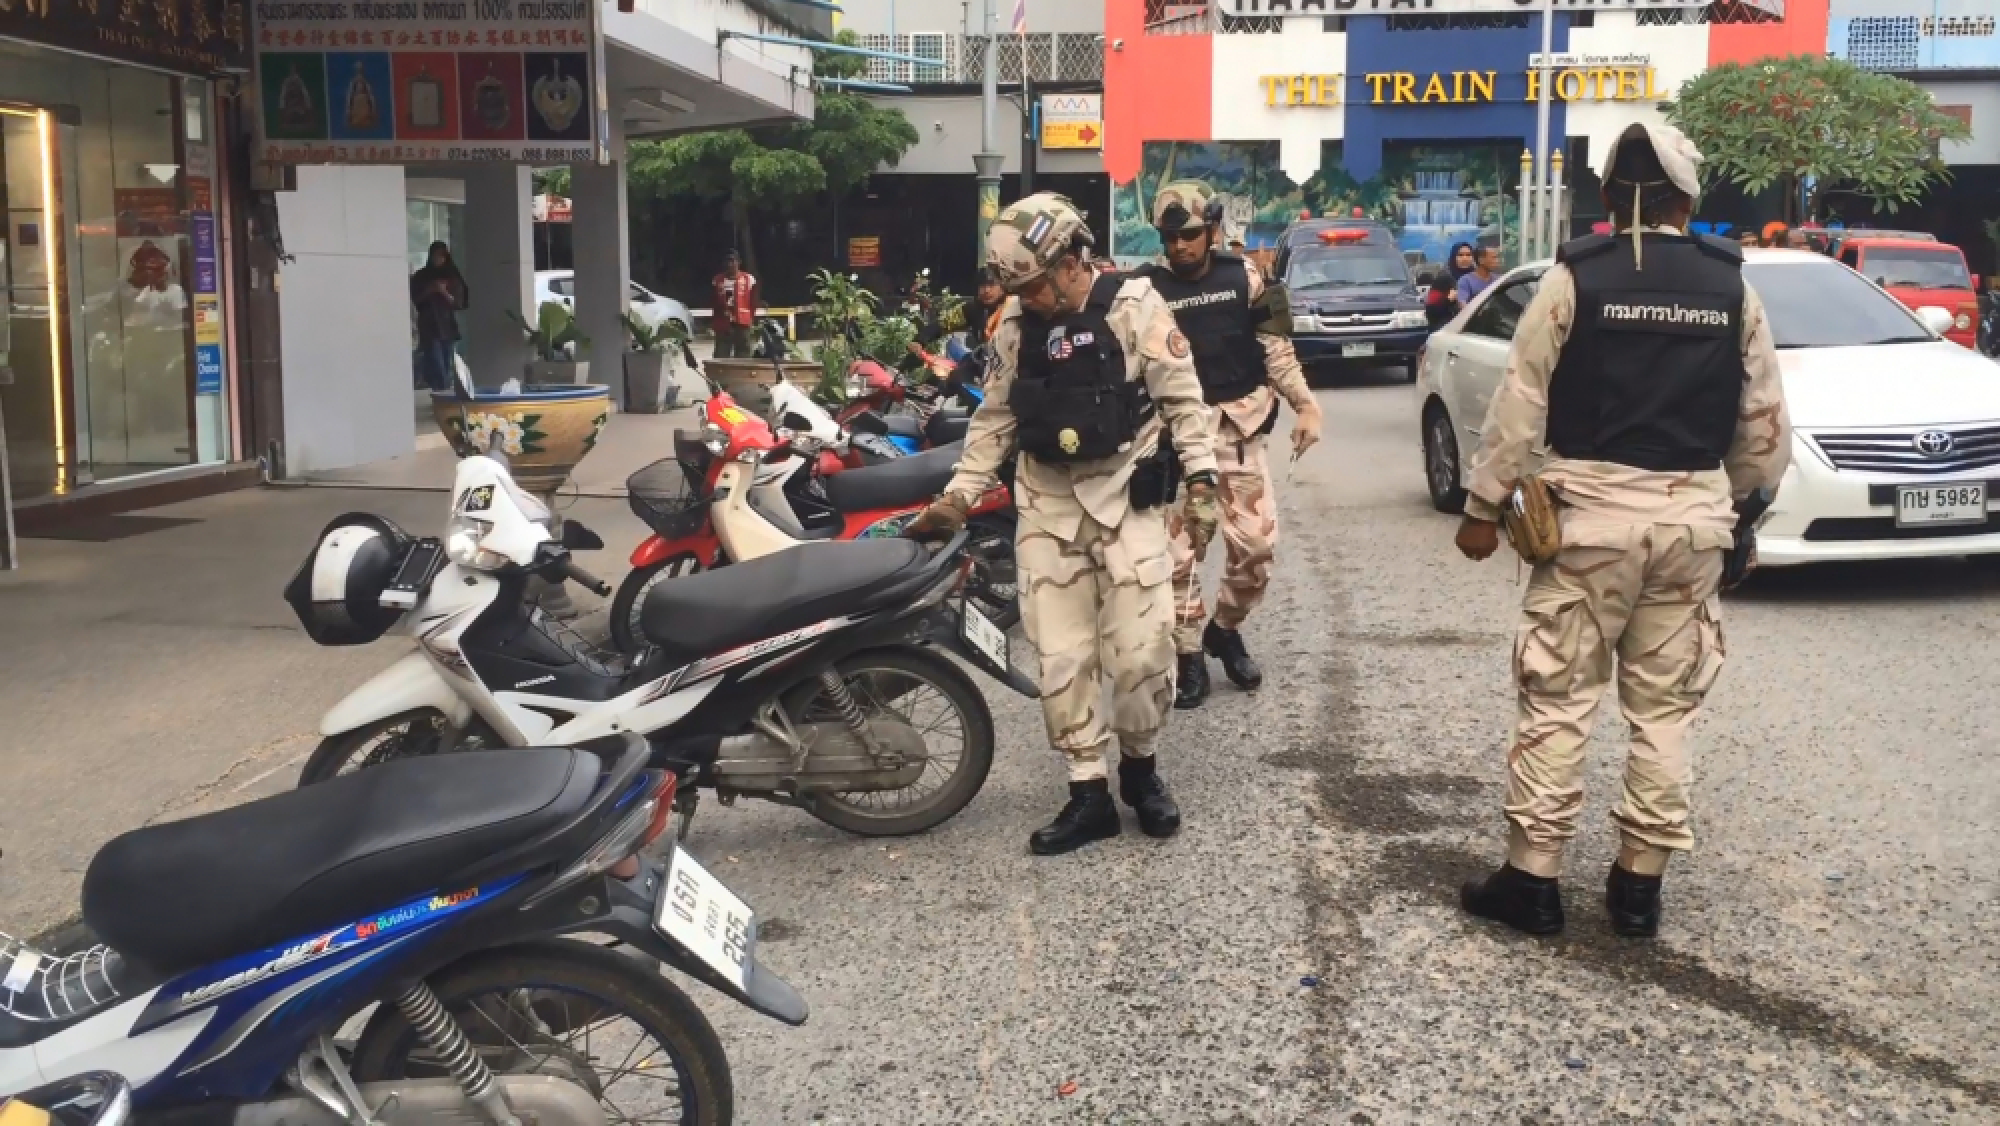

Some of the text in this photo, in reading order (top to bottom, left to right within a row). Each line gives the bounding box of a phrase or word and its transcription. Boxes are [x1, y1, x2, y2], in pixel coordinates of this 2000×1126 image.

[474, 0, 513, 20] 100%
[1259, 66, 1669, 107] THE TRAIN HOTEL
[1603, 303, 1729, 326] กรมการปกครอง
[1935, 487, 1981, 508] 5982
[721, 910, 748, 967] 265
